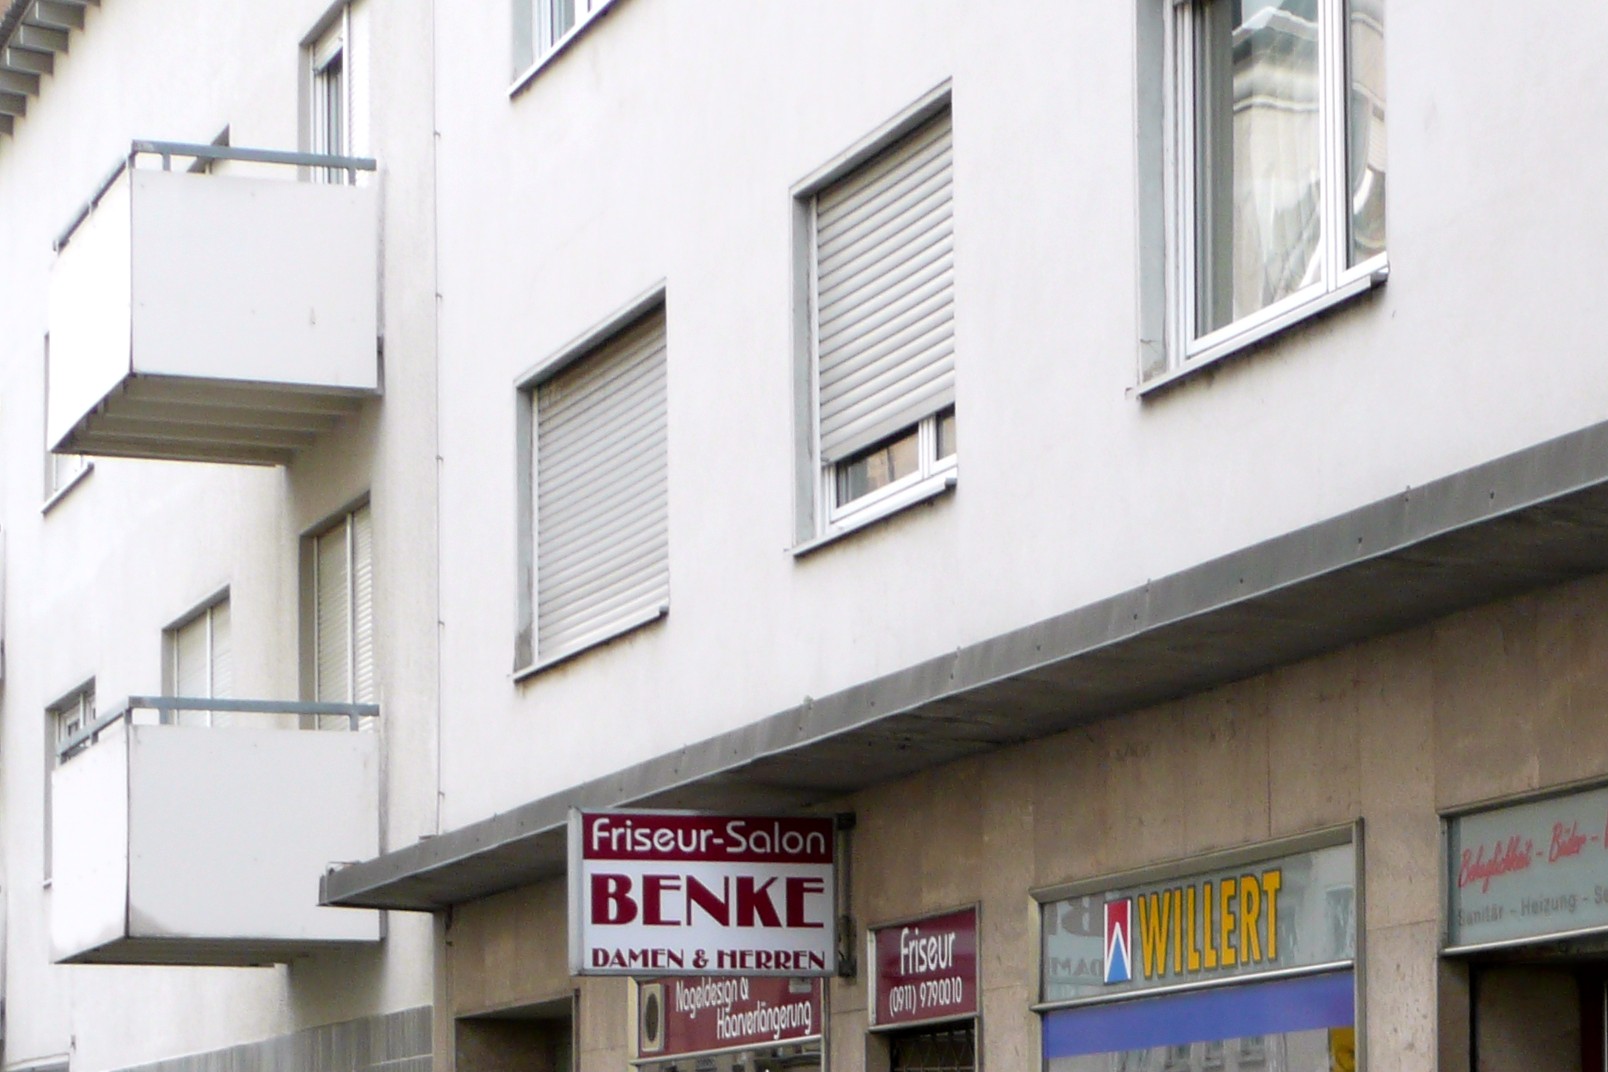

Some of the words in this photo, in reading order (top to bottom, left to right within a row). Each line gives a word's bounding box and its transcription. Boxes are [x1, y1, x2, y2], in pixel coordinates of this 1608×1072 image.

[592, 818, 825, 855] Friseur-Salon
[590, 872, 824, 929] BENKE
[1521, 893, 1576, 918] Heizung
[1137, 868, 1281, 978] WILLERT
[592, 948, 684, 968] DAMEN
[693, 949, 709, 968] &
[717, 949, 825, 970] HERREN
[901, 929, 956, 976] Friseur
[676, 978, 738, 1019] Nageldesign
[889, 987, 916, 1017] (0911)
[921, 977, 962, 1013] 9790010
[717, 1000, 812, 1040] Haarverlängerung
